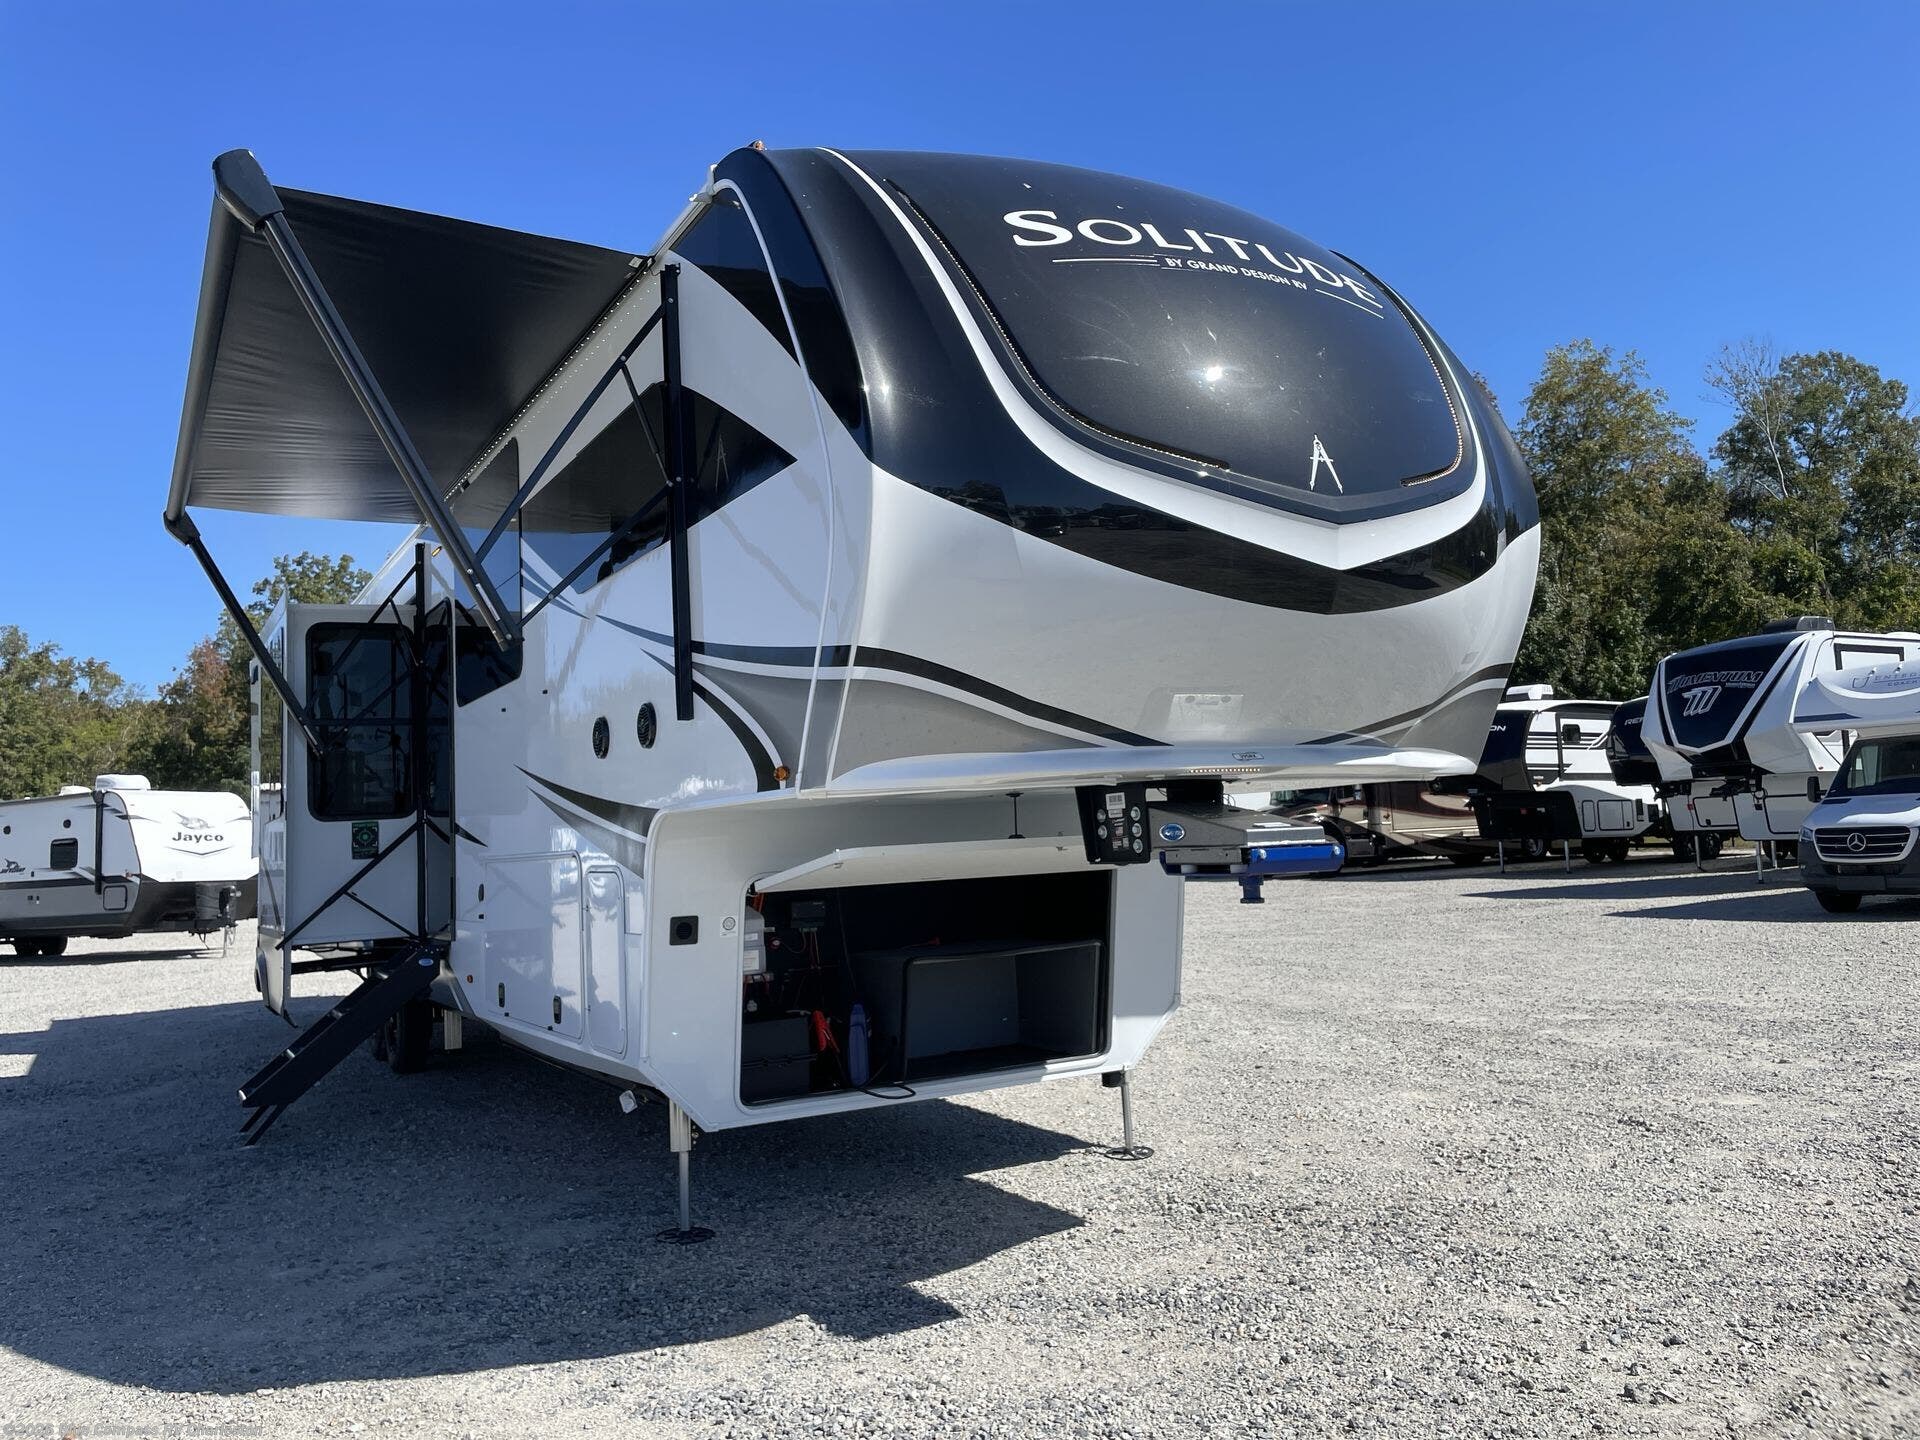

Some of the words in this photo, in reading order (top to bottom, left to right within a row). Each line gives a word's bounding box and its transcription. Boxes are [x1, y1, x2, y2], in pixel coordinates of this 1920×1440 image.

[1003, 209, 1383, 309] SOLITUDE
[1165, 257, 1182, 268] BY
[1187, 260, 1238, 275] GRAND
[1241, 267, 1290, 286] DESIGN
[1291, 279, 1308, 291] RV
[172, 831, 224, 844] Jayco
